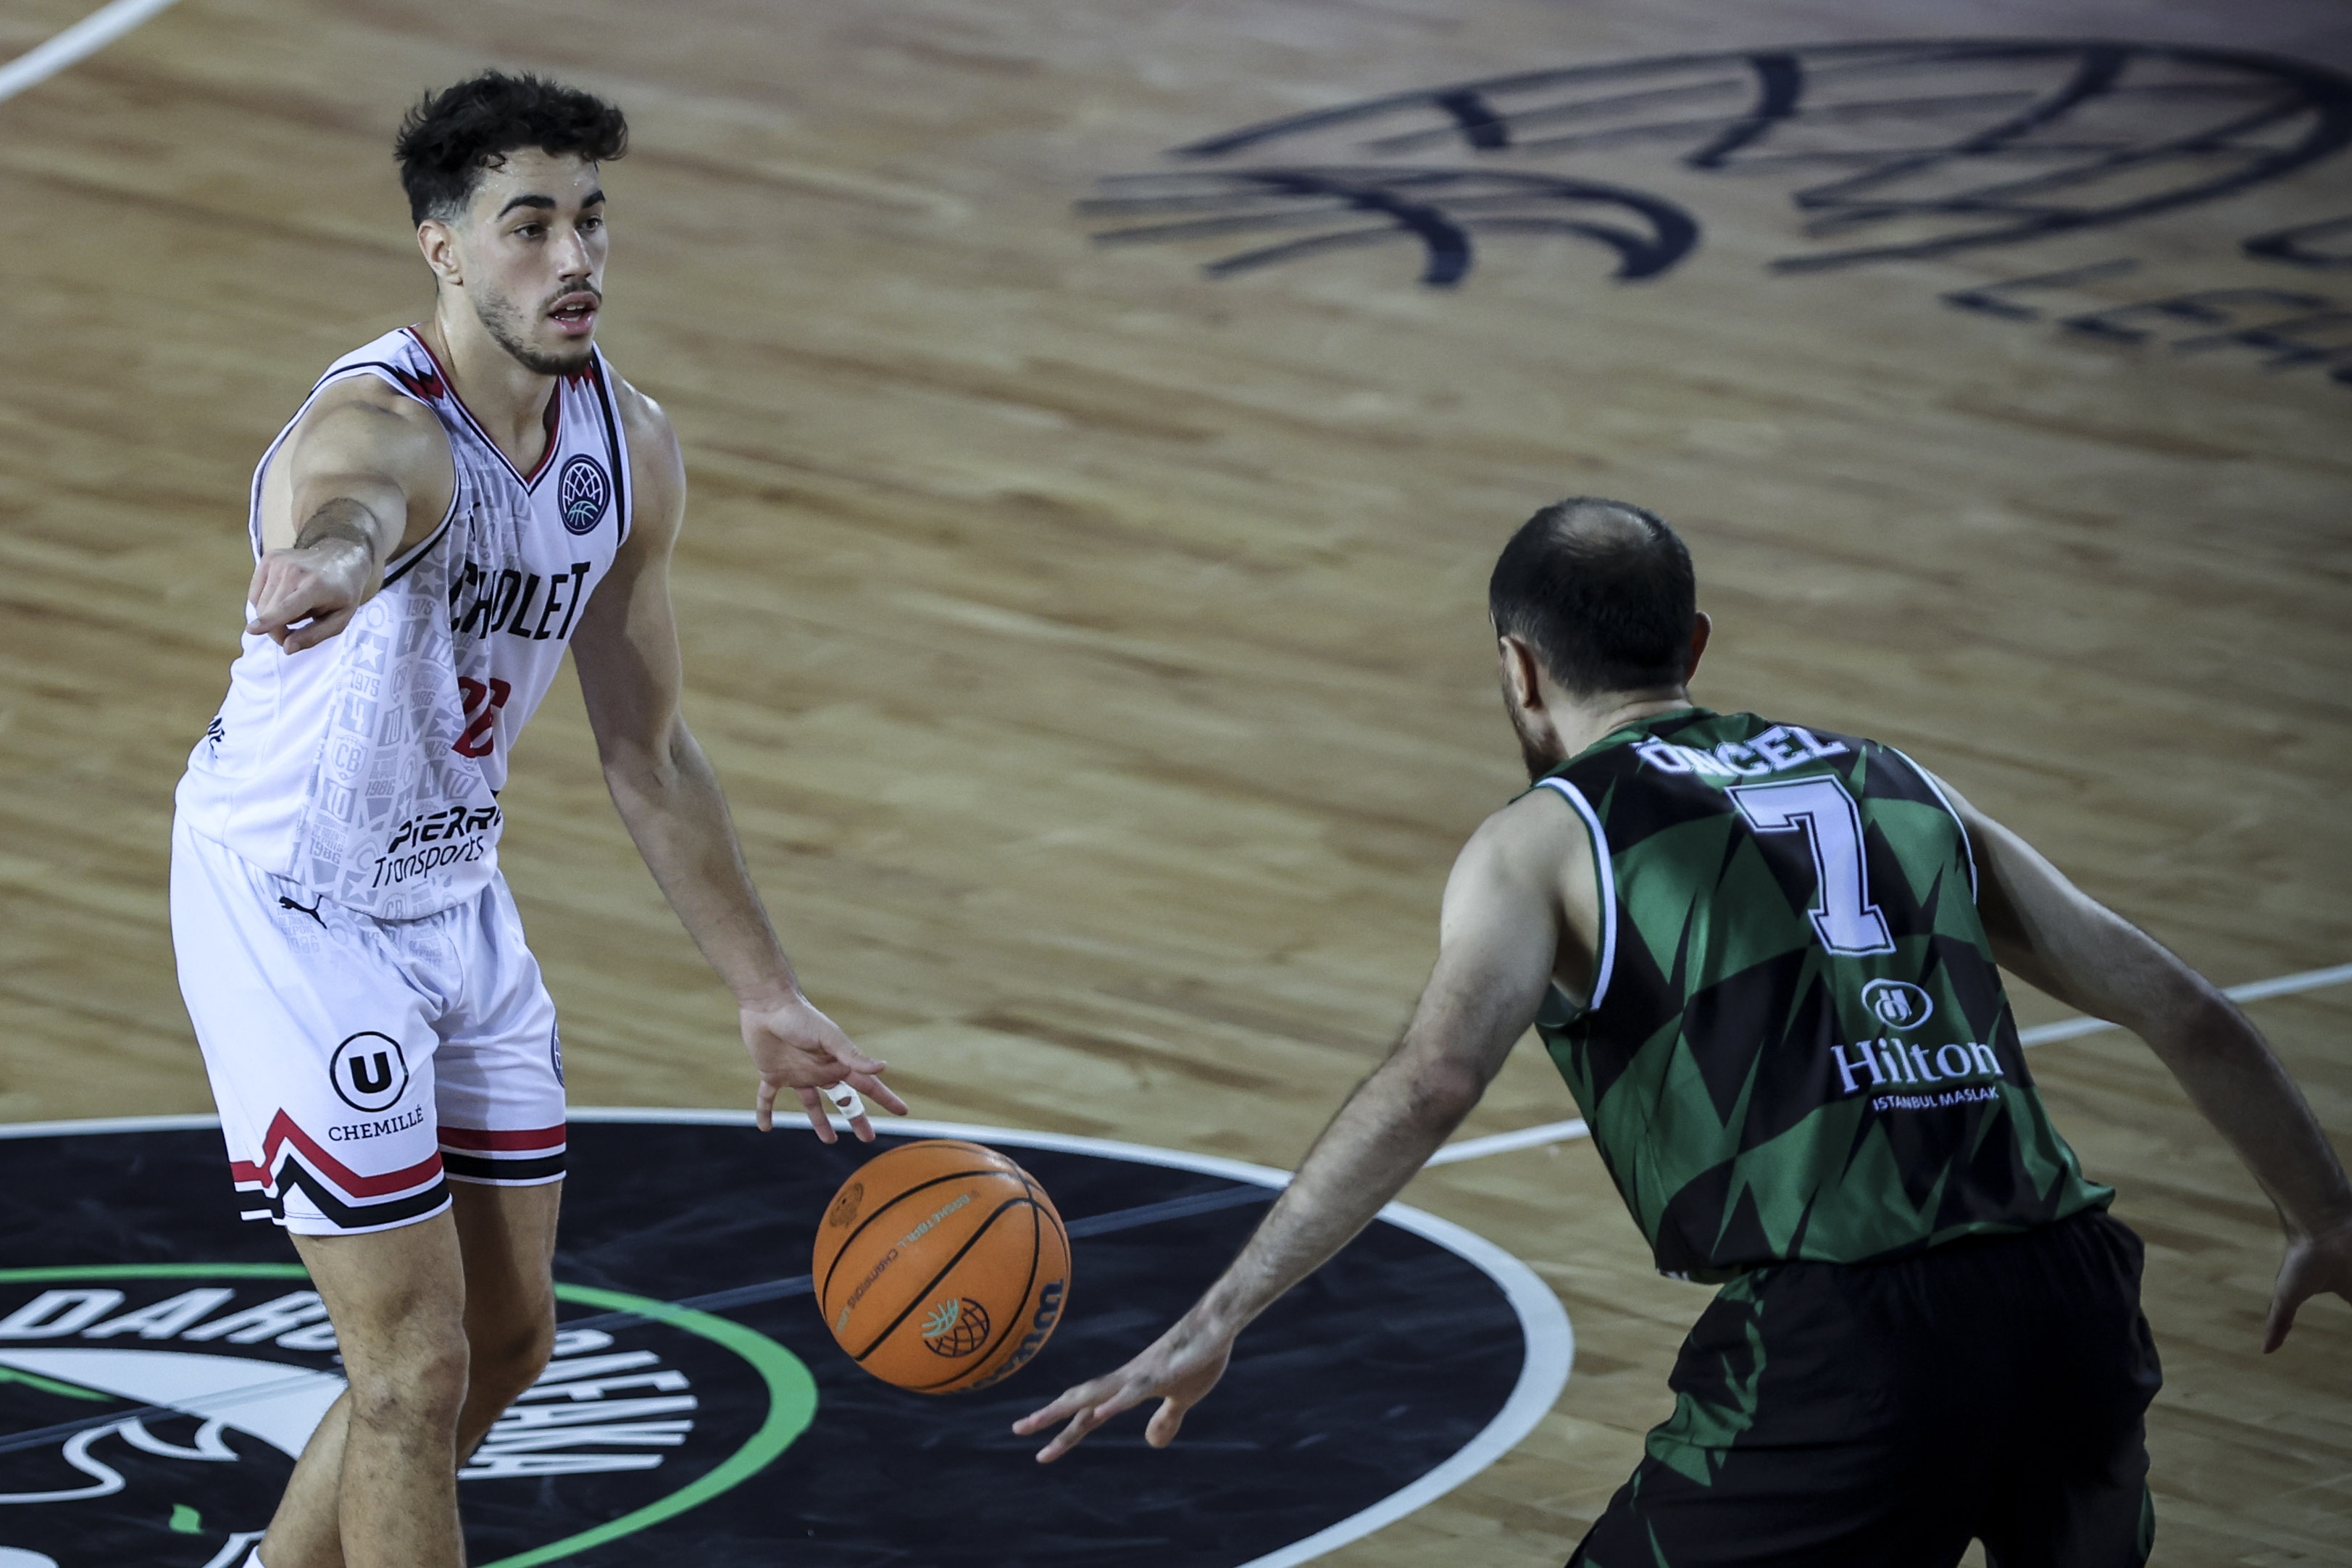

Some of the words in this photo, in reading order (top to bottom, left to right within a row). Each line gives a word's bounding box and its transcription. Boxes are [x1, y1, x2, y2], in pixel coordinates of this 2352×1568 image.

[449, 561, 591, 640] CHOLET
[1630, 725, 1850, 776] ÖNCEL
[372, 835, 484, 888] Transports
[1724, 774, 1897, 956] 7
[349, 1051, 392, 1093] U
[1831, 1038, 2004, 1093] Hilton
[328, 1104, 424, 1141] CHEMILLÉ
[1872, 1093, 1938, 1112] ISTANBUL
[1939, 1085, 1999, 1106] MASLAK
